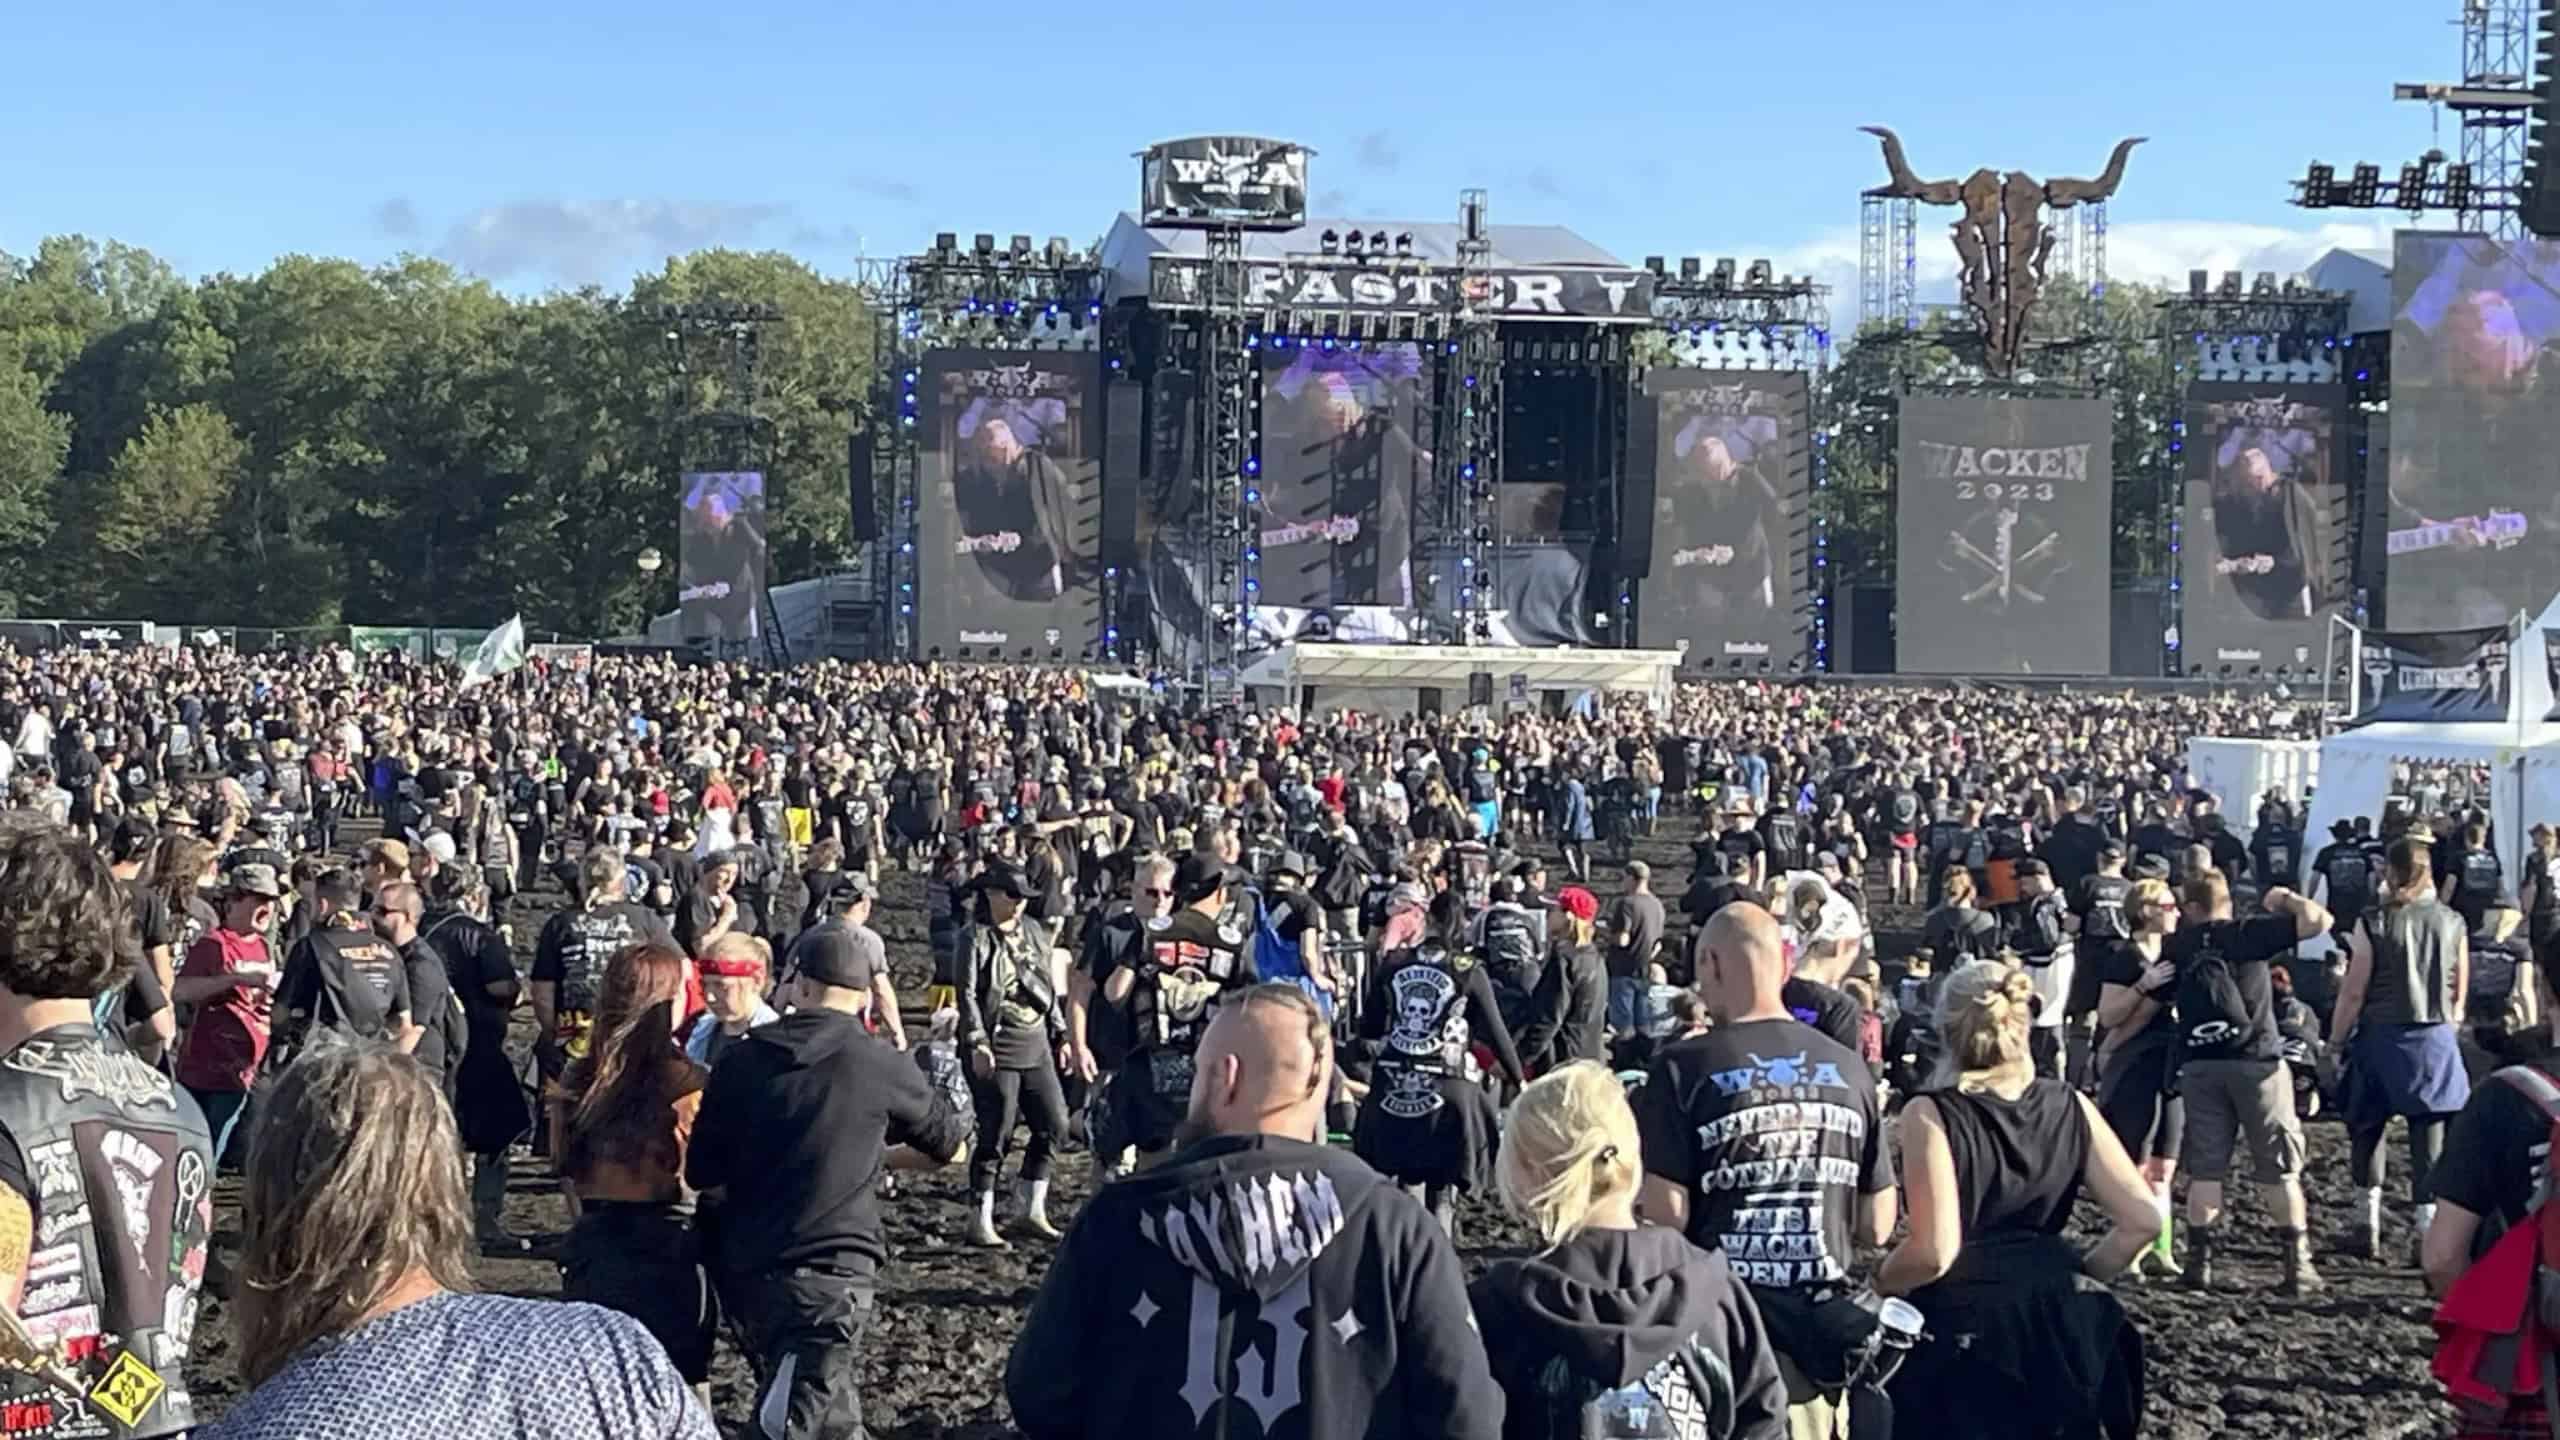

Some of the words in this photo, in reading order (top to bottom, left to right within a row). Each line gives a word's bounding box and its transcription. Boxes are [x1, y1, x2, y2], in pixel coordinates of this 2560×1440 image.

[1919, 439, 2092, 482] WACKEN
[1957, 481, 2054, 501] 2023
[1696, 1102, 1863, 1151] NEVERMIND
[1733, 1207, 1805, 1233] THIS
[1719, 1231, 1827, 1261] WACK
[1729, 1260, 1793, 1287] PEN
